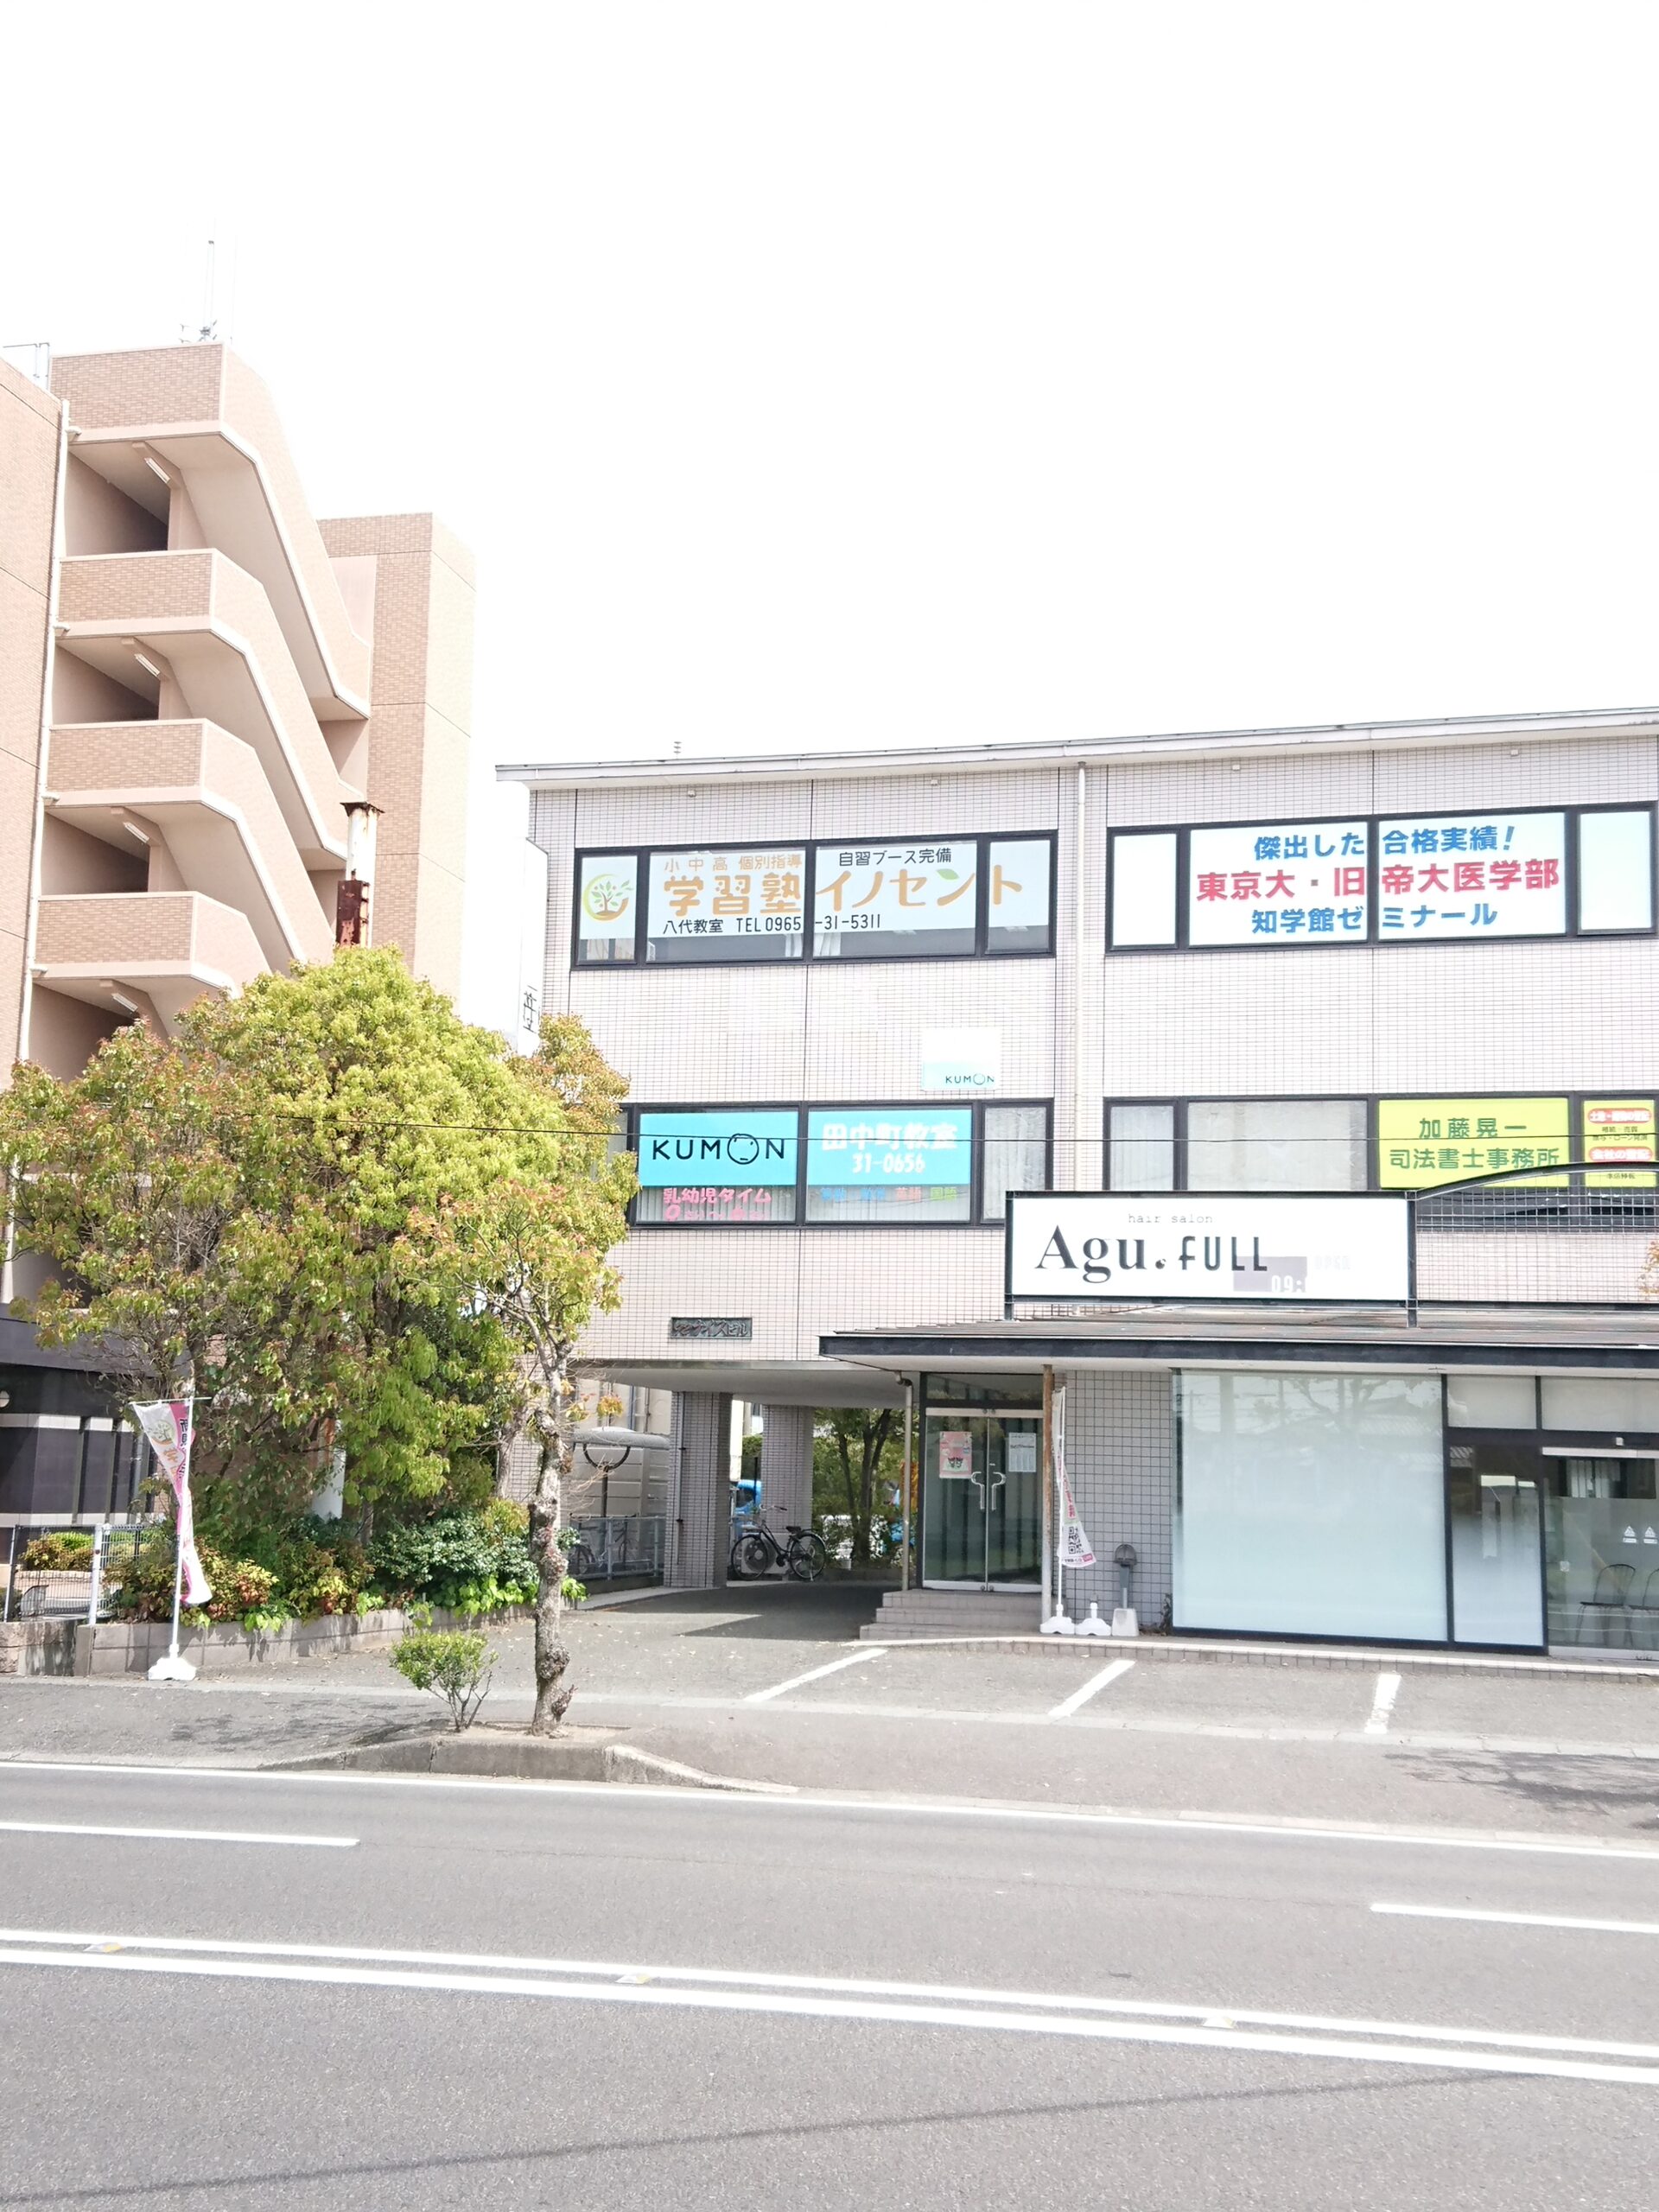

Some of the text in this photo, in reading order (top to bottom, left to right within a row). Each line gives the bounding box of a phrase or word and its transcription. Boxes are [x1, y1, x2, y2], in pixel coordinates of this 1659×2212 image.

[739, 854, 803, 871] 個別指導
[838, 848, 952, 867] 自習ブース完備
[663, 918, 724, 934] 八代教室
[945, 1073, 995, 1085] KUMON
[652, 1133, 785, 1165] KUMON
[852, 1153, 925, 1174] 31-0656
[1389, 1147, 1560, 1170] 司法書士事務所
[663, 1187, 772, 1204] 乳幼児タイム
[1128, 1213, 1214, 1224] hair salon
